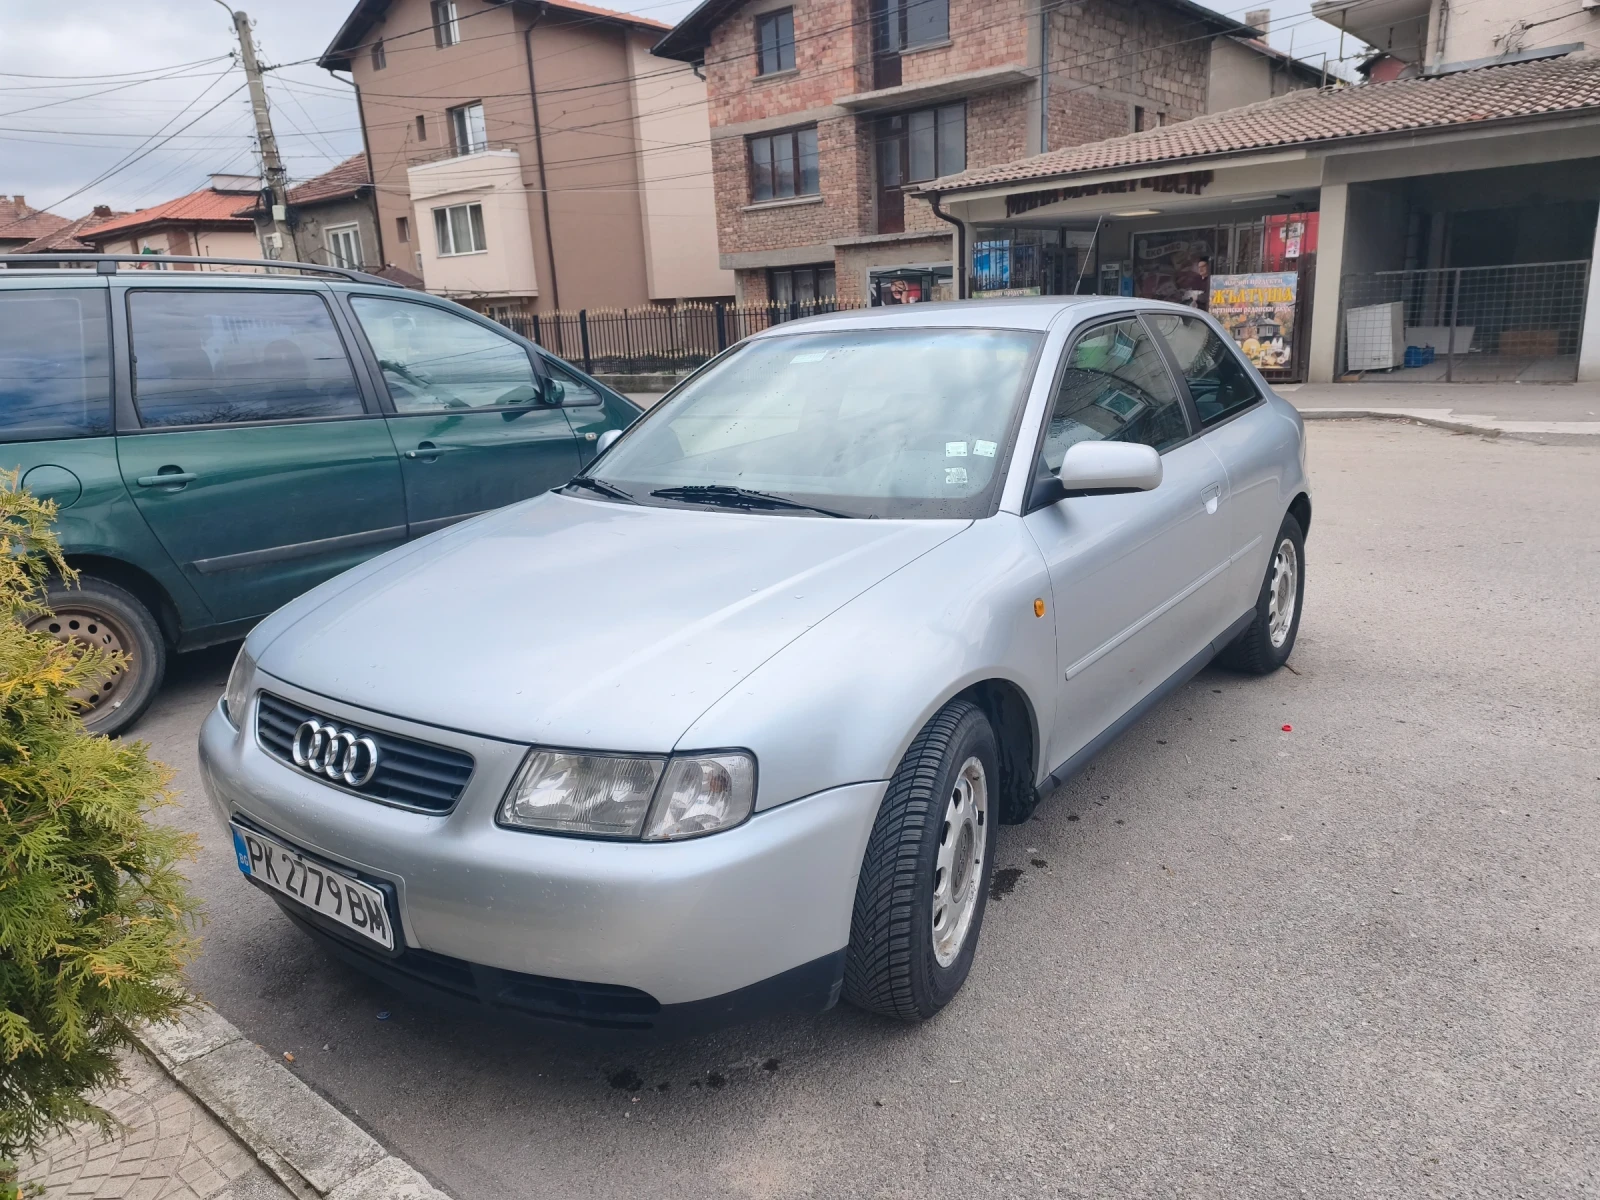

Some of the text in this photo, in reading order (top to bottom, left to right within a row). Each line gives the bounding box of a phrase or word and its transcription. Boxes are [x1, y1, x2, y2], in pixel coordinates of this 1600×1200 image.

[1146, 248, 1162, 258] ЕКО
[1212, 287, 1293, 305] ЖЪЛТУША
[238, 852, 250, 867] BG
[245, 835, 387, 940] PK 2779 BM
